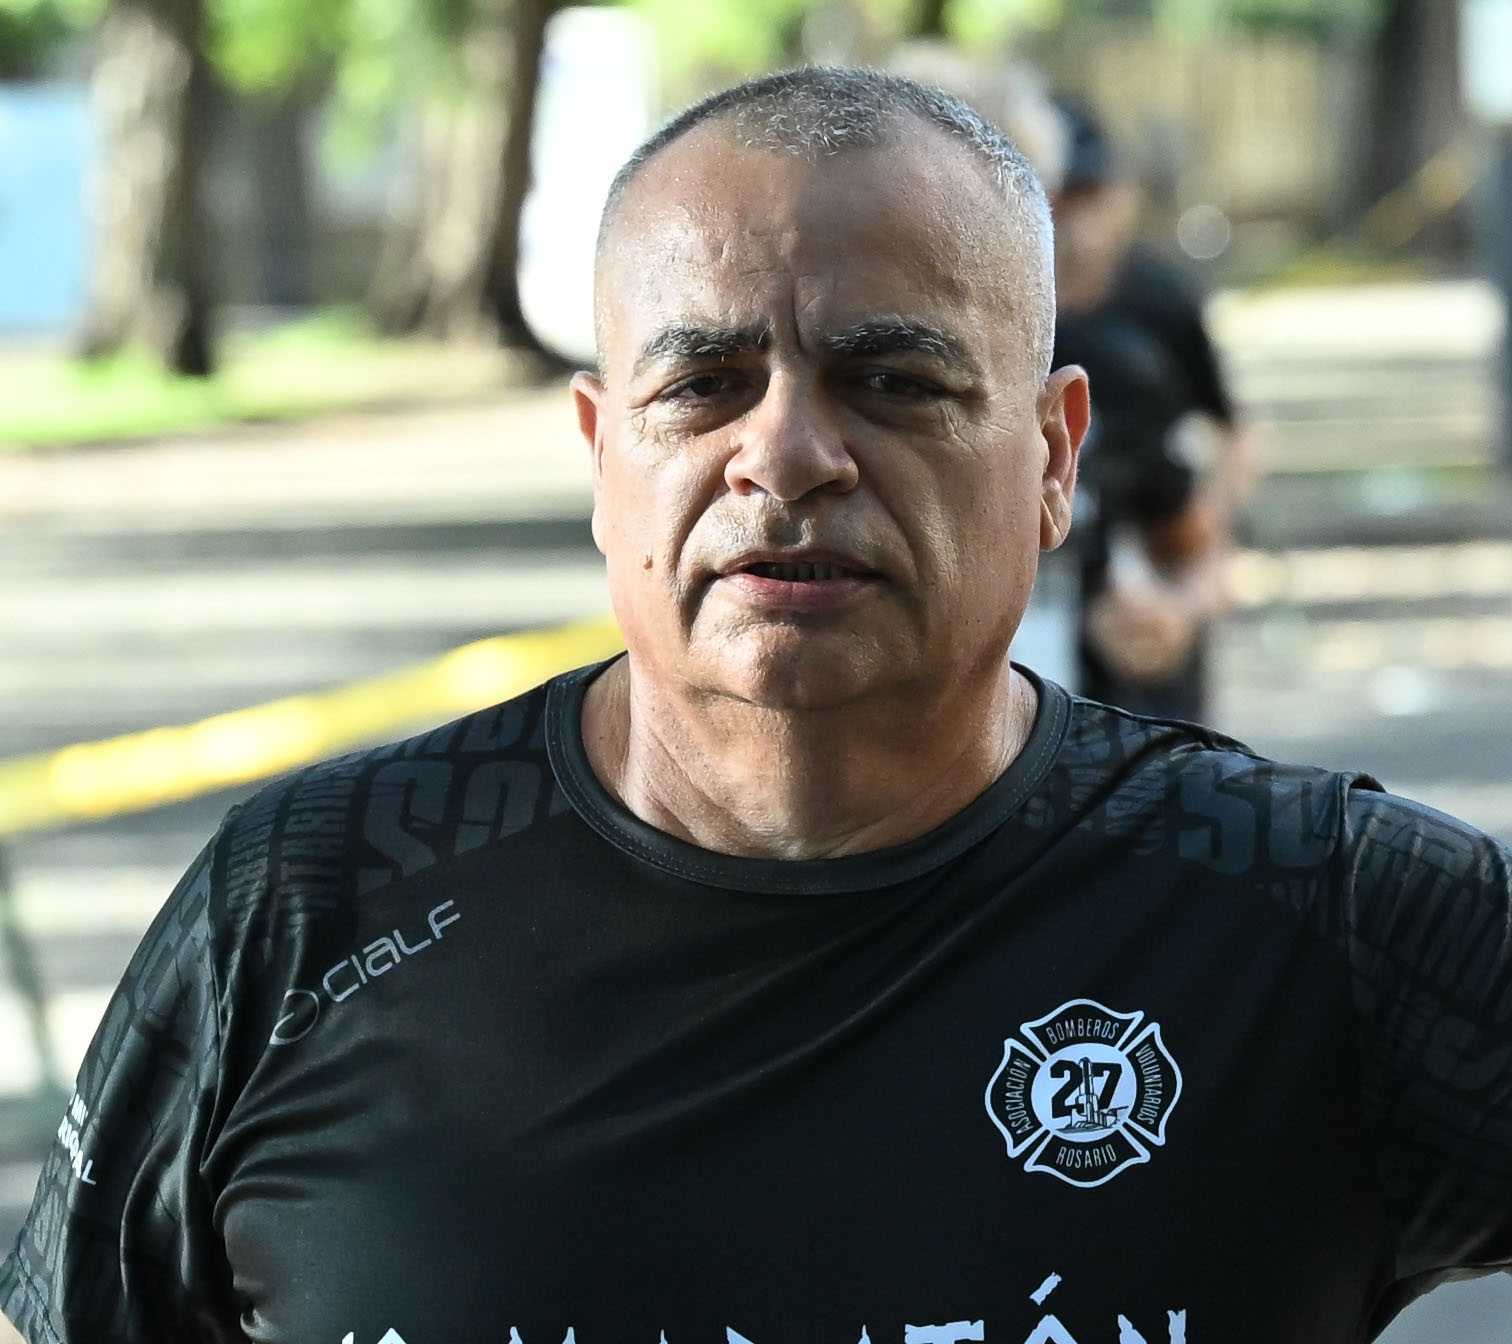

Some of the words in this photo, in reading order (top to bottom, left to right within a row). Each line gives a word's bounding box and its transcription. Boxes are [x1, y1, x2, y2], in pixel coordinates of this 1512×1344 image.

[1046, 1019, 1120, 1045] BOMBEROS
[1004, 1058, 1034, 1135] ASOCIACIÓN
[1050, 1059, 1123, 1119] 27
[1136, 1043, 1164, 1126] VOLUNTARIOS
[1055, 1143, 1118, 1169] ROSARIO
